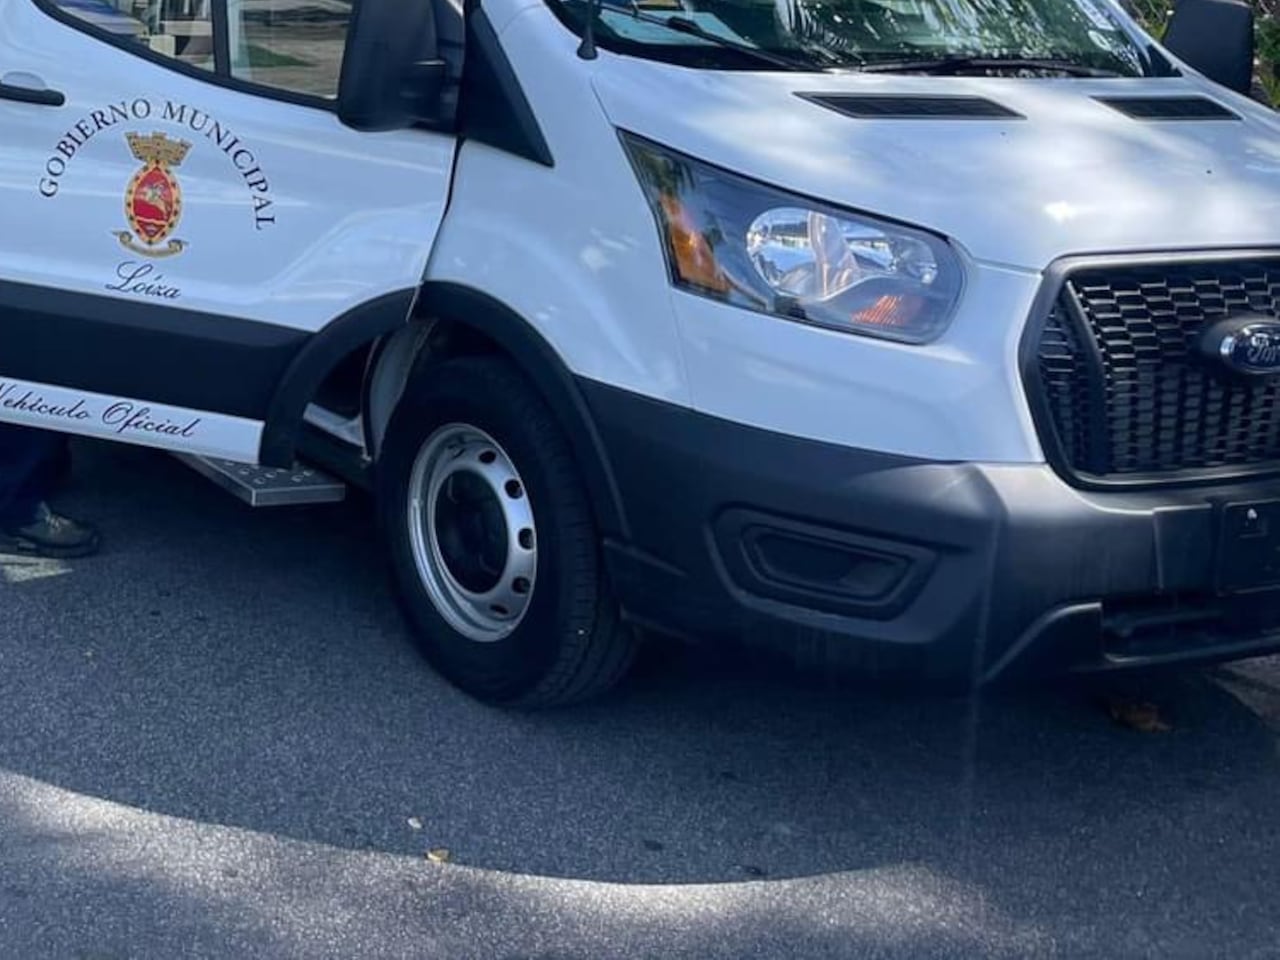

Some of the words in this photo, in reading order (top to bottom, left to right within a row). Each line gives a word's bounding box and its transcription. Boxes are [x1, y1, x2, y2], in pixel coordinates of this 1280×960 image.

[39, 98, 151, 198] GOBIERNO
[162, 100, 276, 231] MUNICIPAL
[104, 261, 181, 298] Loíza
[102, 401, 201, 437] Oficial
